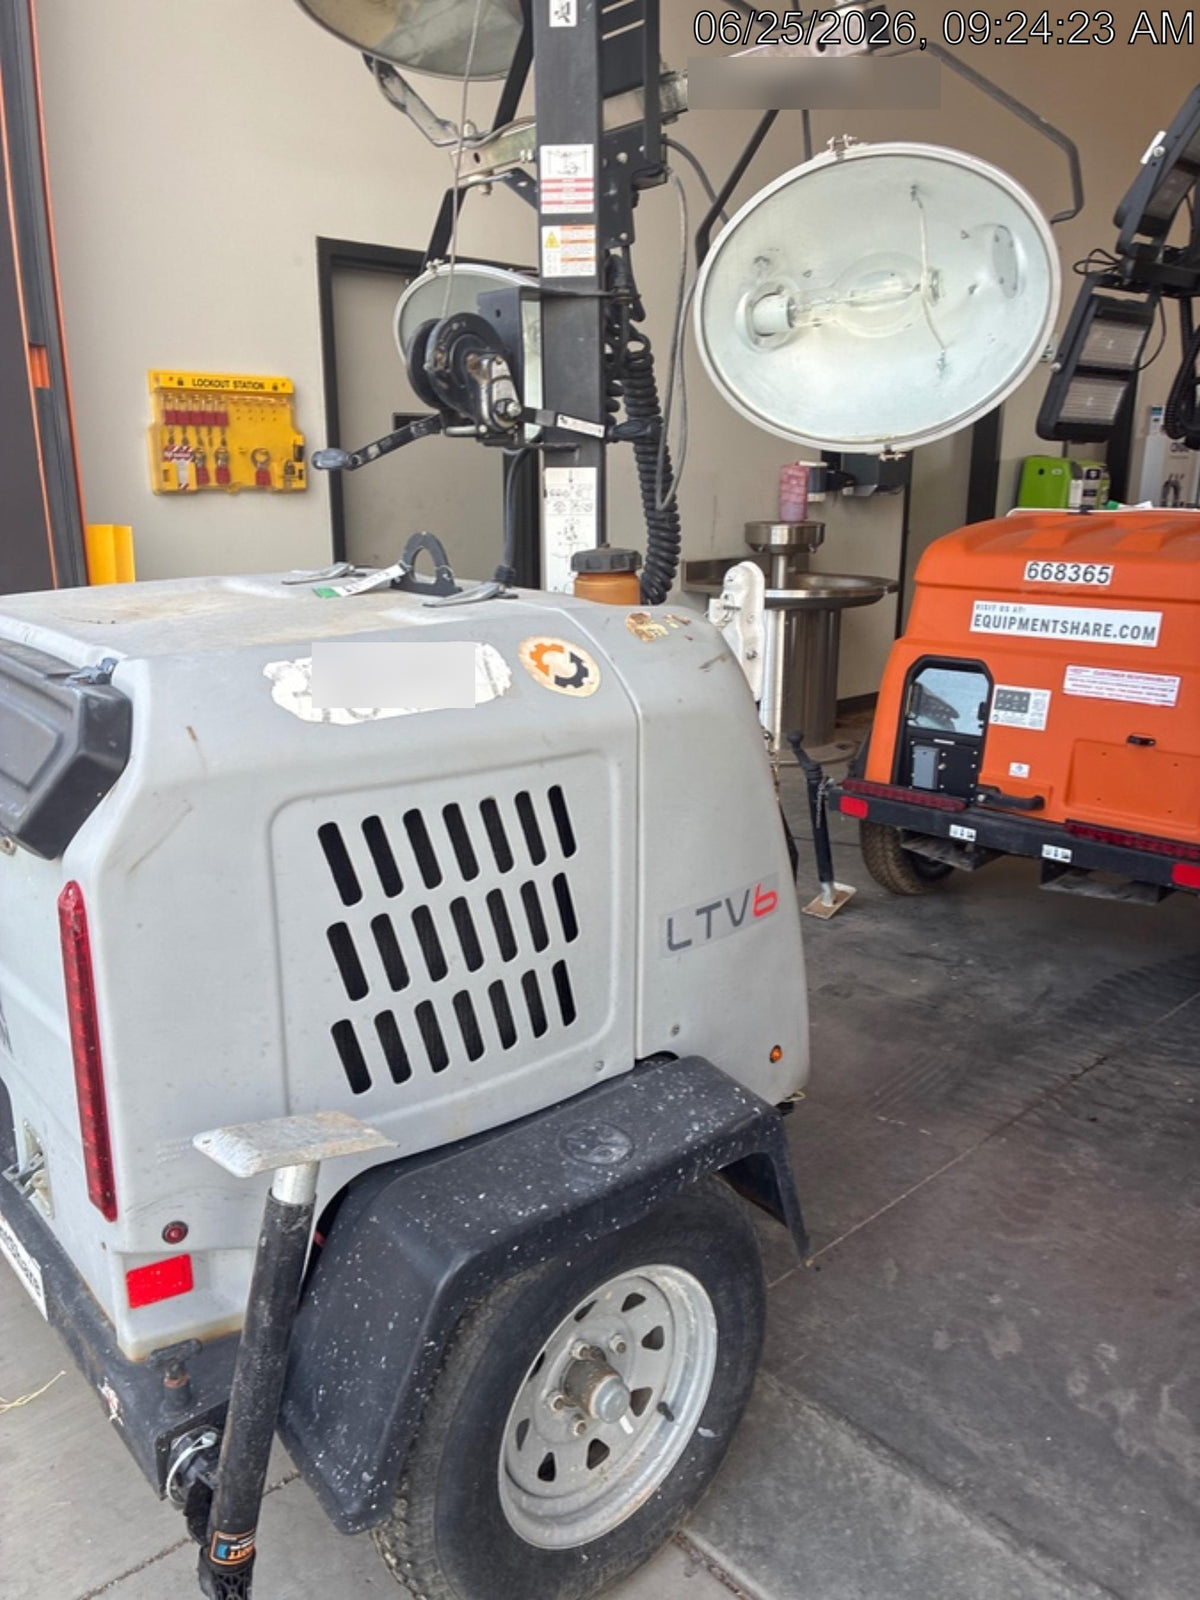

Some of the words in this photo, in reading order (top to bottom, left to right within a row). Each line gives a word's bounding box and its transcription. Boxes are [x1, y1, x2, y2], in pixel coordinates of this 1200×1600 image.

[192, 378, 230, 388] LOCKOUT
[233, 380, 265, 390] STATION
[1027, 562, 1111, 584] 668365
[974, 613, 1157, 641] EQUIPMENTSHARE.COM
[667, 882, 779, 951] LTV6
